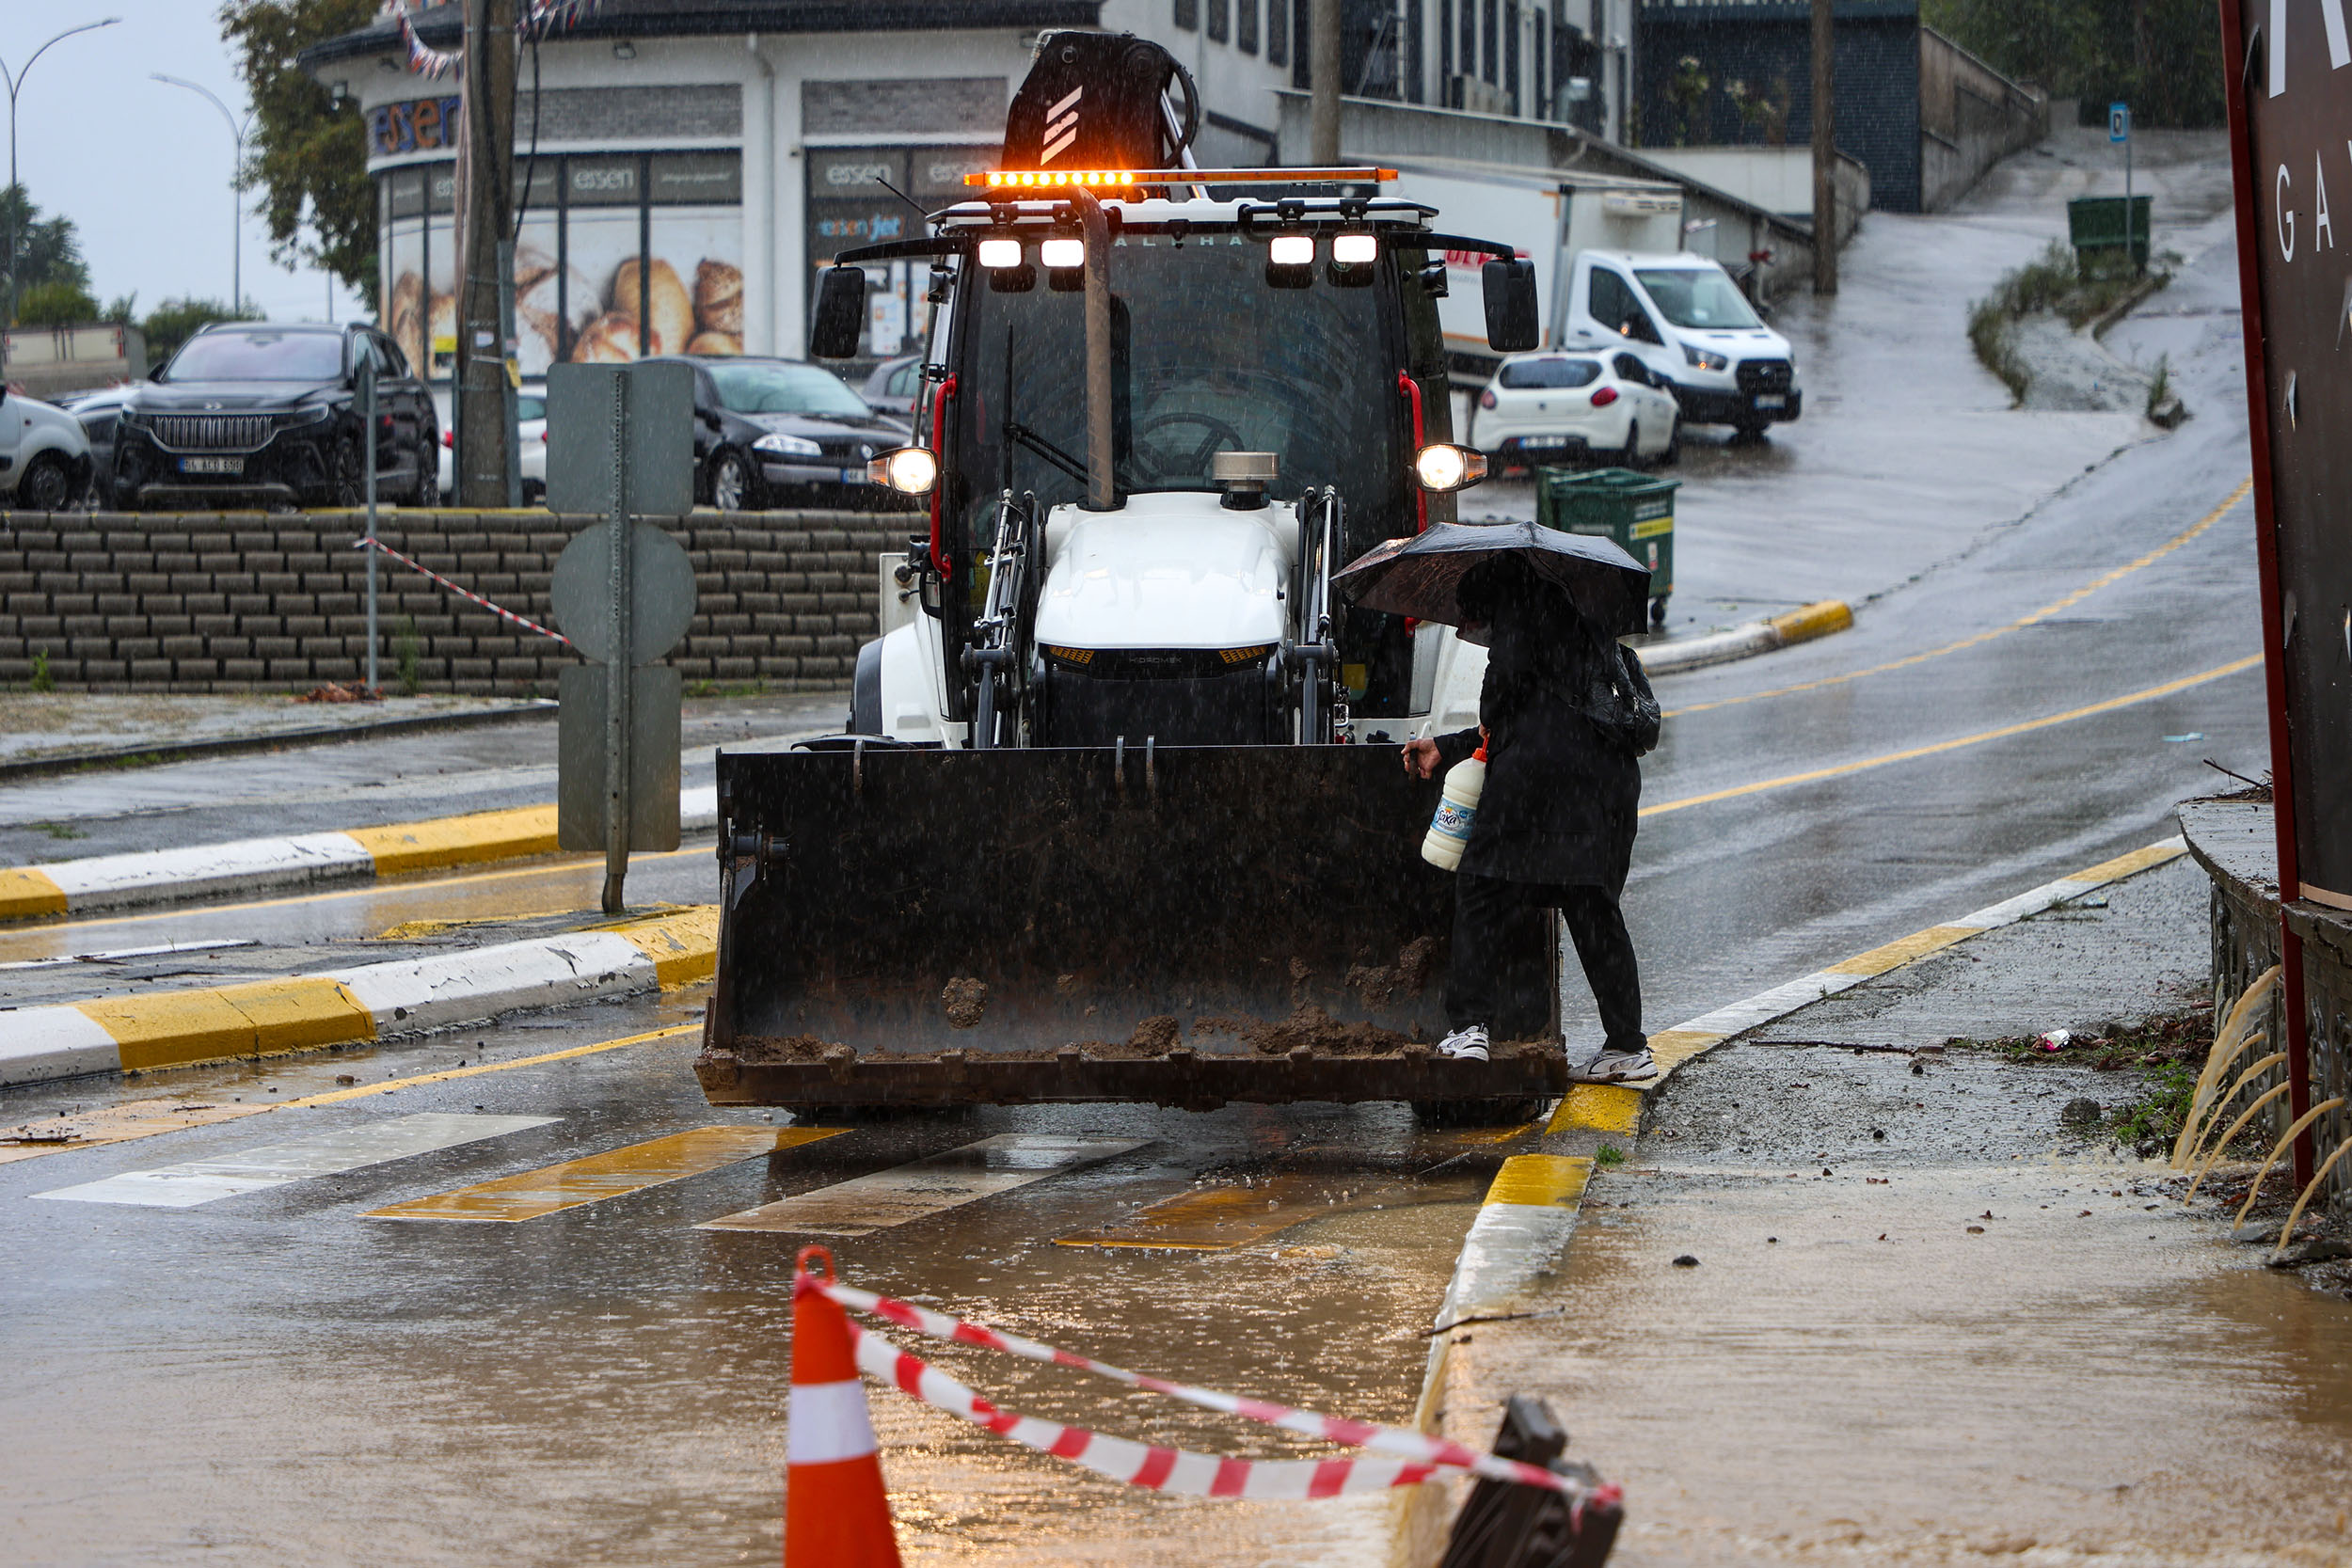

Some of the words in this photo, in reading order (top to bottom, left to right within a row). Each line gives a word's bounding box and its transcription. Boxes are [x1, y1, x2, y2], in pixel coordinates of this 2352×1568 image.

[574, 167, 634, 189] essen
[826, 164, 892, 184] essen
[2276, 140, 2352, 263] GA
